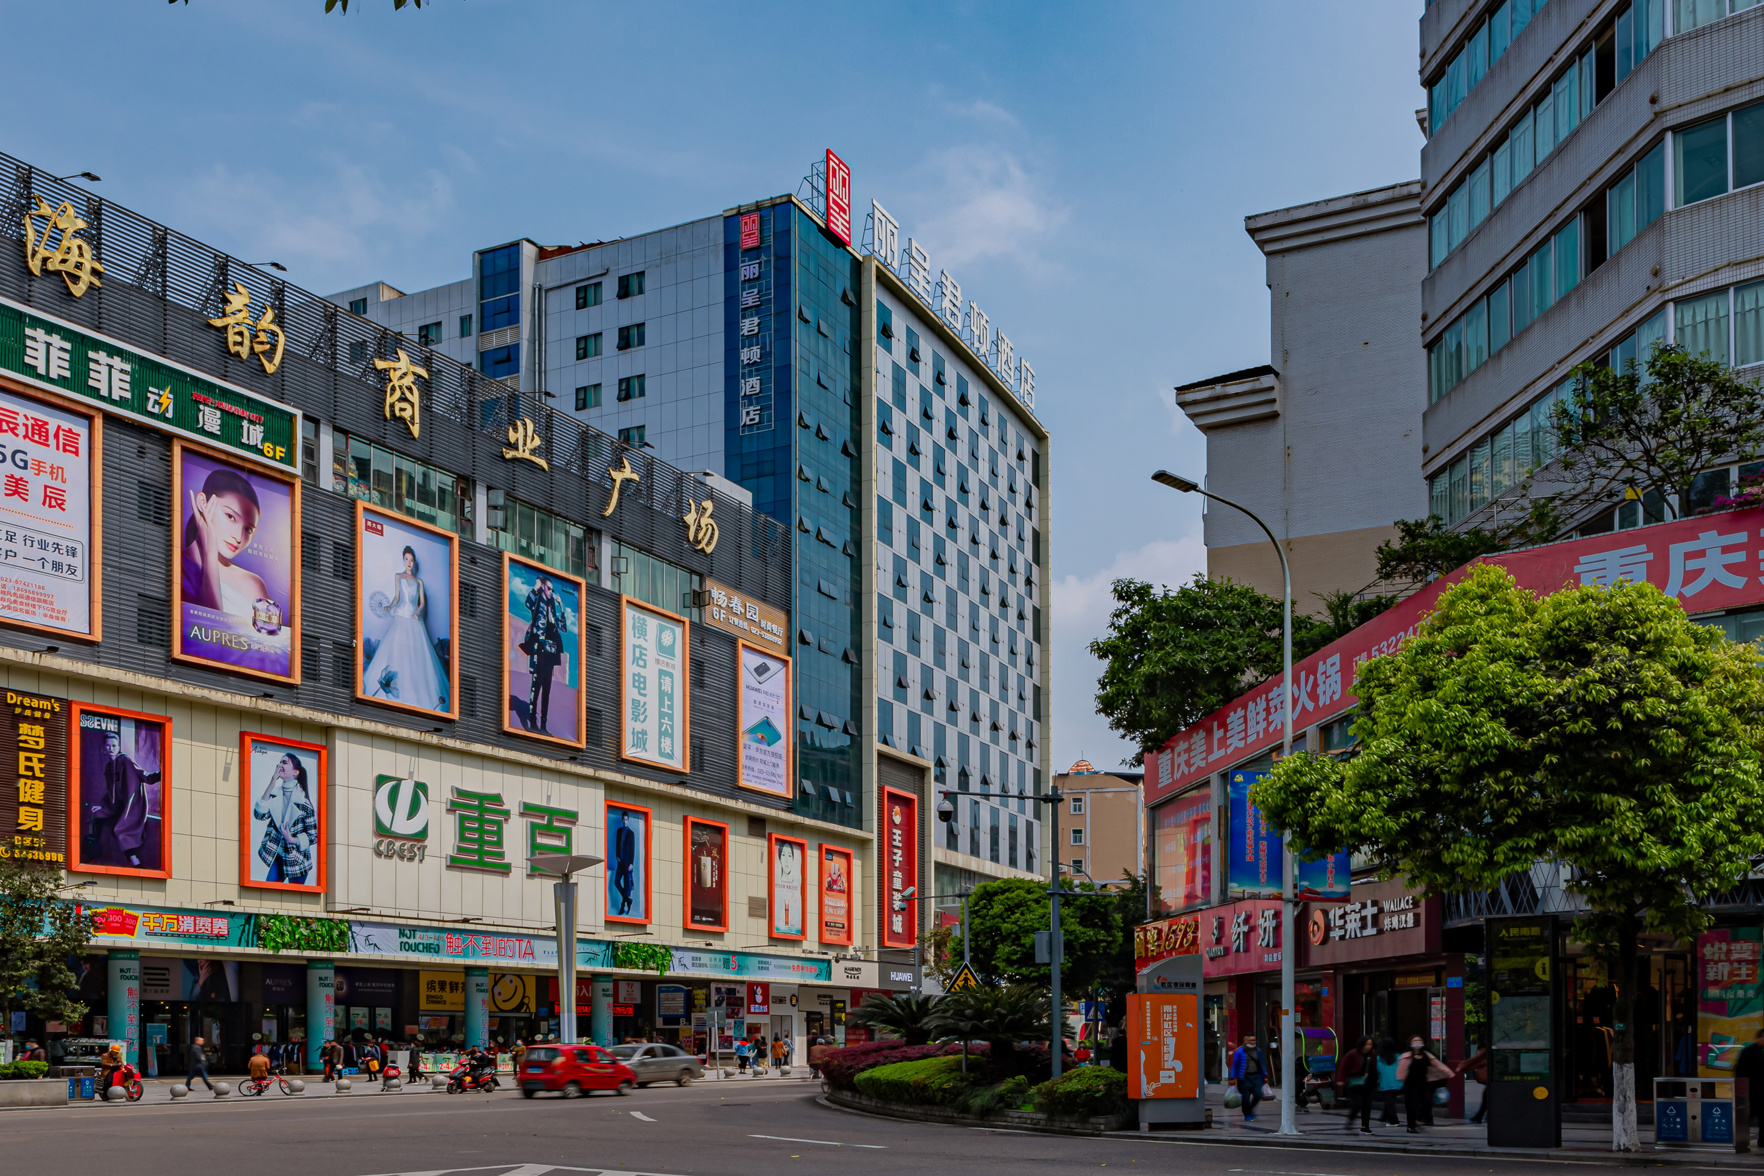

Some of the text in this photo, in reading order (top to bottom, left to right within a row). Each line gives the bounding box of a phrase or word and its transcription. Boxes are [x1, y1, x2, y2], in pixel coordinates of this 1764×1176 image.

[829, 152, 850, 245] 丽呈
[872, 198, 1036, 412] 丽呈君顿酒店
[740, 260, 760, 426] 丽呈君顿酒店
[263, 442, 286, 460] 6F
[0, 528, 78, 559] 足 行业先锋
[22, 555, 78, 577] 一个朋友
[1574, 529, 1764, 600] 重庆
[711, 587, 759, 622] 畅春园
[712, 607, 726, 622] 6F
[190, 625, 249, 650] AUPRES
[631, 613, 648, 754] 横店电影城
[6, 691, 60, 712] Dream's
[660, 675, 673, 755] 请上六楼
[1158, 653, 1341, 788] 重庆美上美鲜菜火锅
[18, 722, 45, 831] 梦氏健身
[446, 785, 579, 879] 重百
[374, 838, 428, 861] CBEST
[892, 819, 902, 934] 王子童装城
[1383, 896, 1413, 913] WALLACE
[142, 912, 229, 936] 千万消费券
[1329, 900, 1378, 941] 华莱士
[1384, 912, 1414, 932] 炸鸡汉堡
[1499, 927, 1541, 937] 人民南路
[445, 932, 535, 960] 触不到的TA
[1703, 942, 1754, 960] 蜕变
[890, 971, 913, 982] HUAWEI
[1705, 962, 1753, 981] 新生
